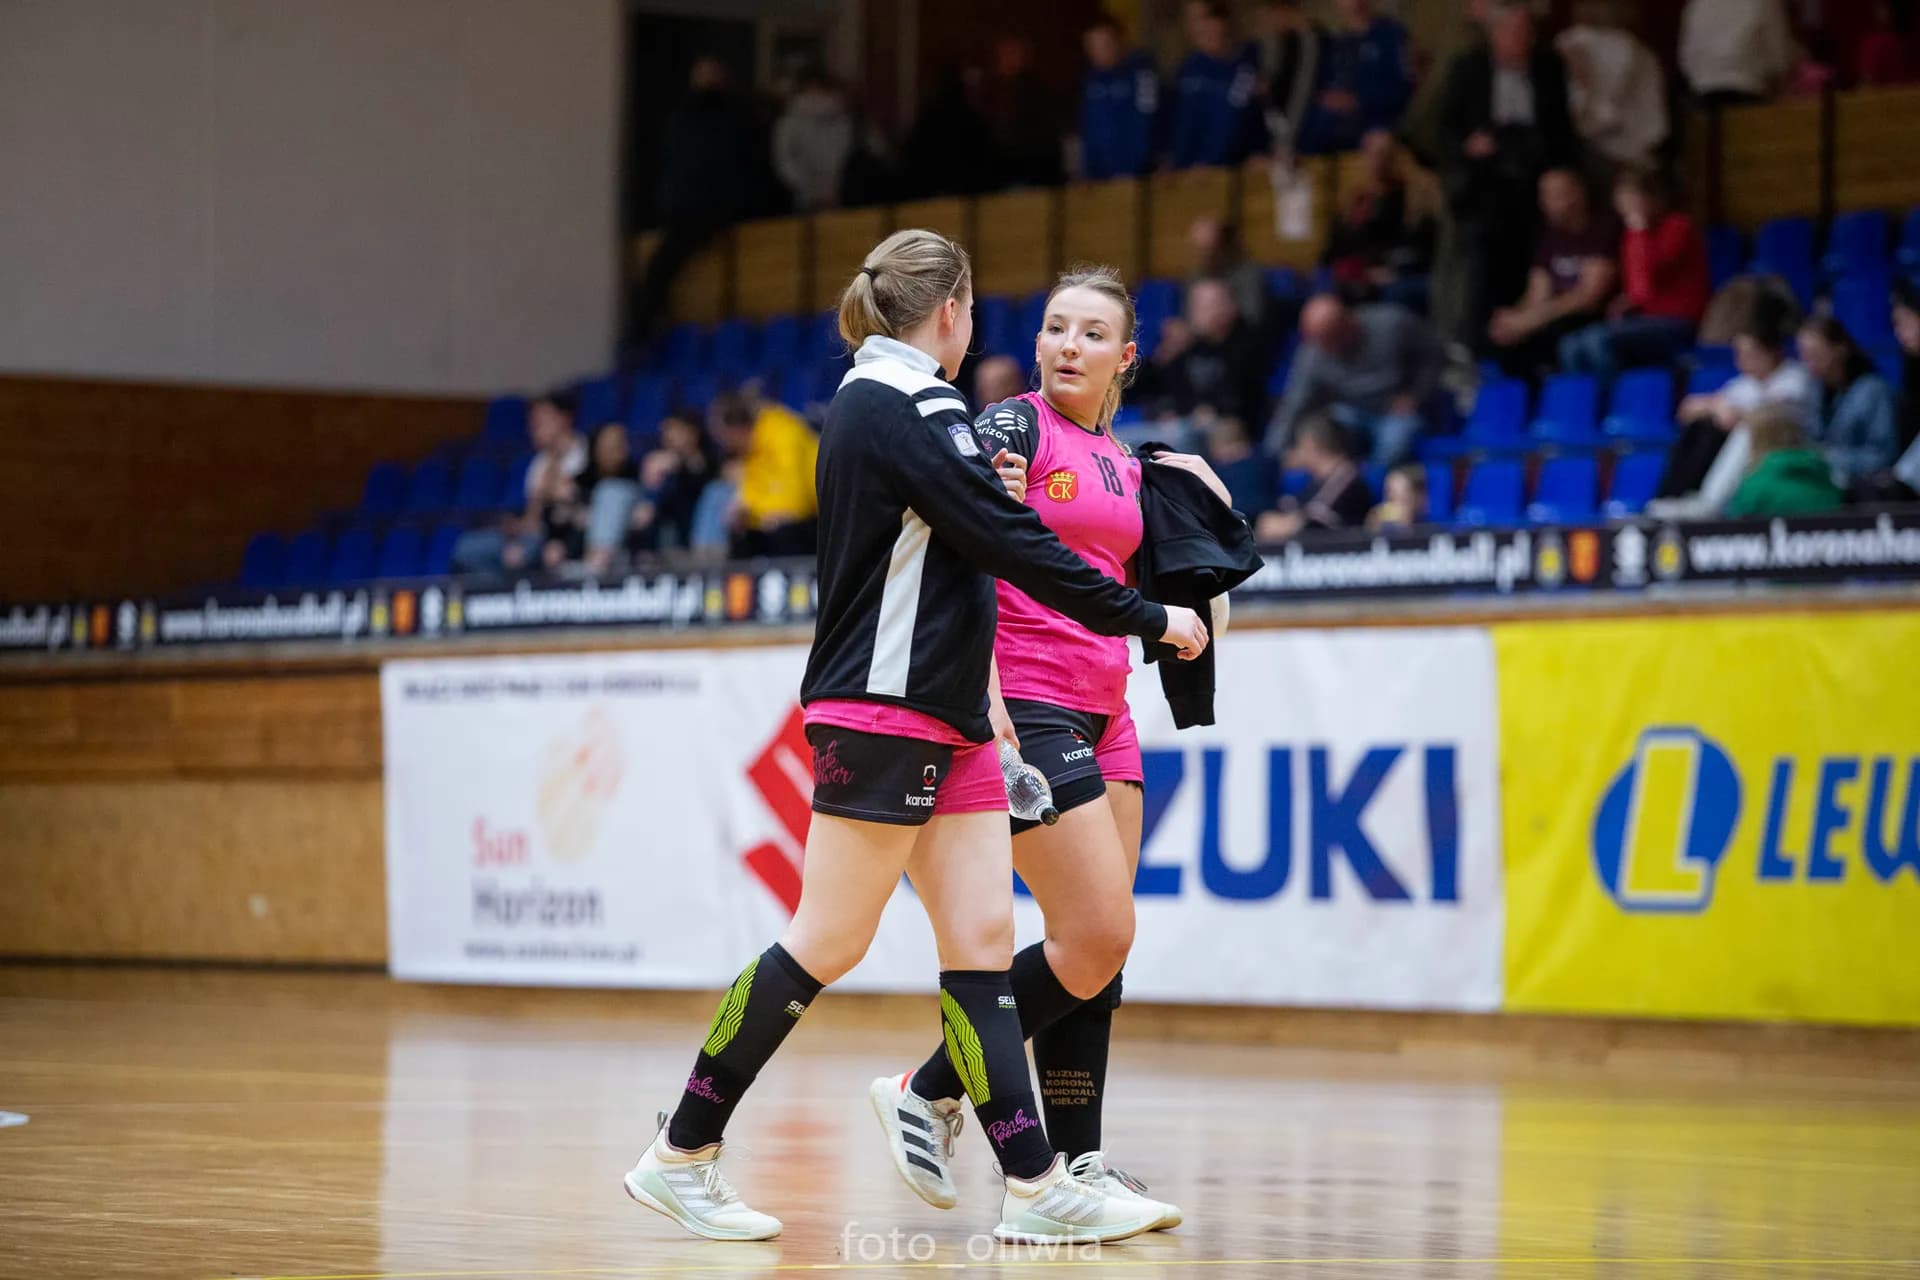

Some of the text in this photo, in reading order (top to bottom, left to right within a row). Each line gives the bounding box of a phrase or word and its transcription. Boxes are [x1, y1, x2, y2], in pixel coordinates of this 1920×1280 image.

[977, 425, 1010, 443] orizon
[1091, 452, 1124, 496] 18
[1048, 482, 1073, 499] CK
[1013, 743, 1458, 904] ZUKI
[1046, 1070, 1090, 1079] SUZUKI
[1046, 1079, 1094, 1087] KORONA
[1051, 1097, 1089, 1105] KIELCE
